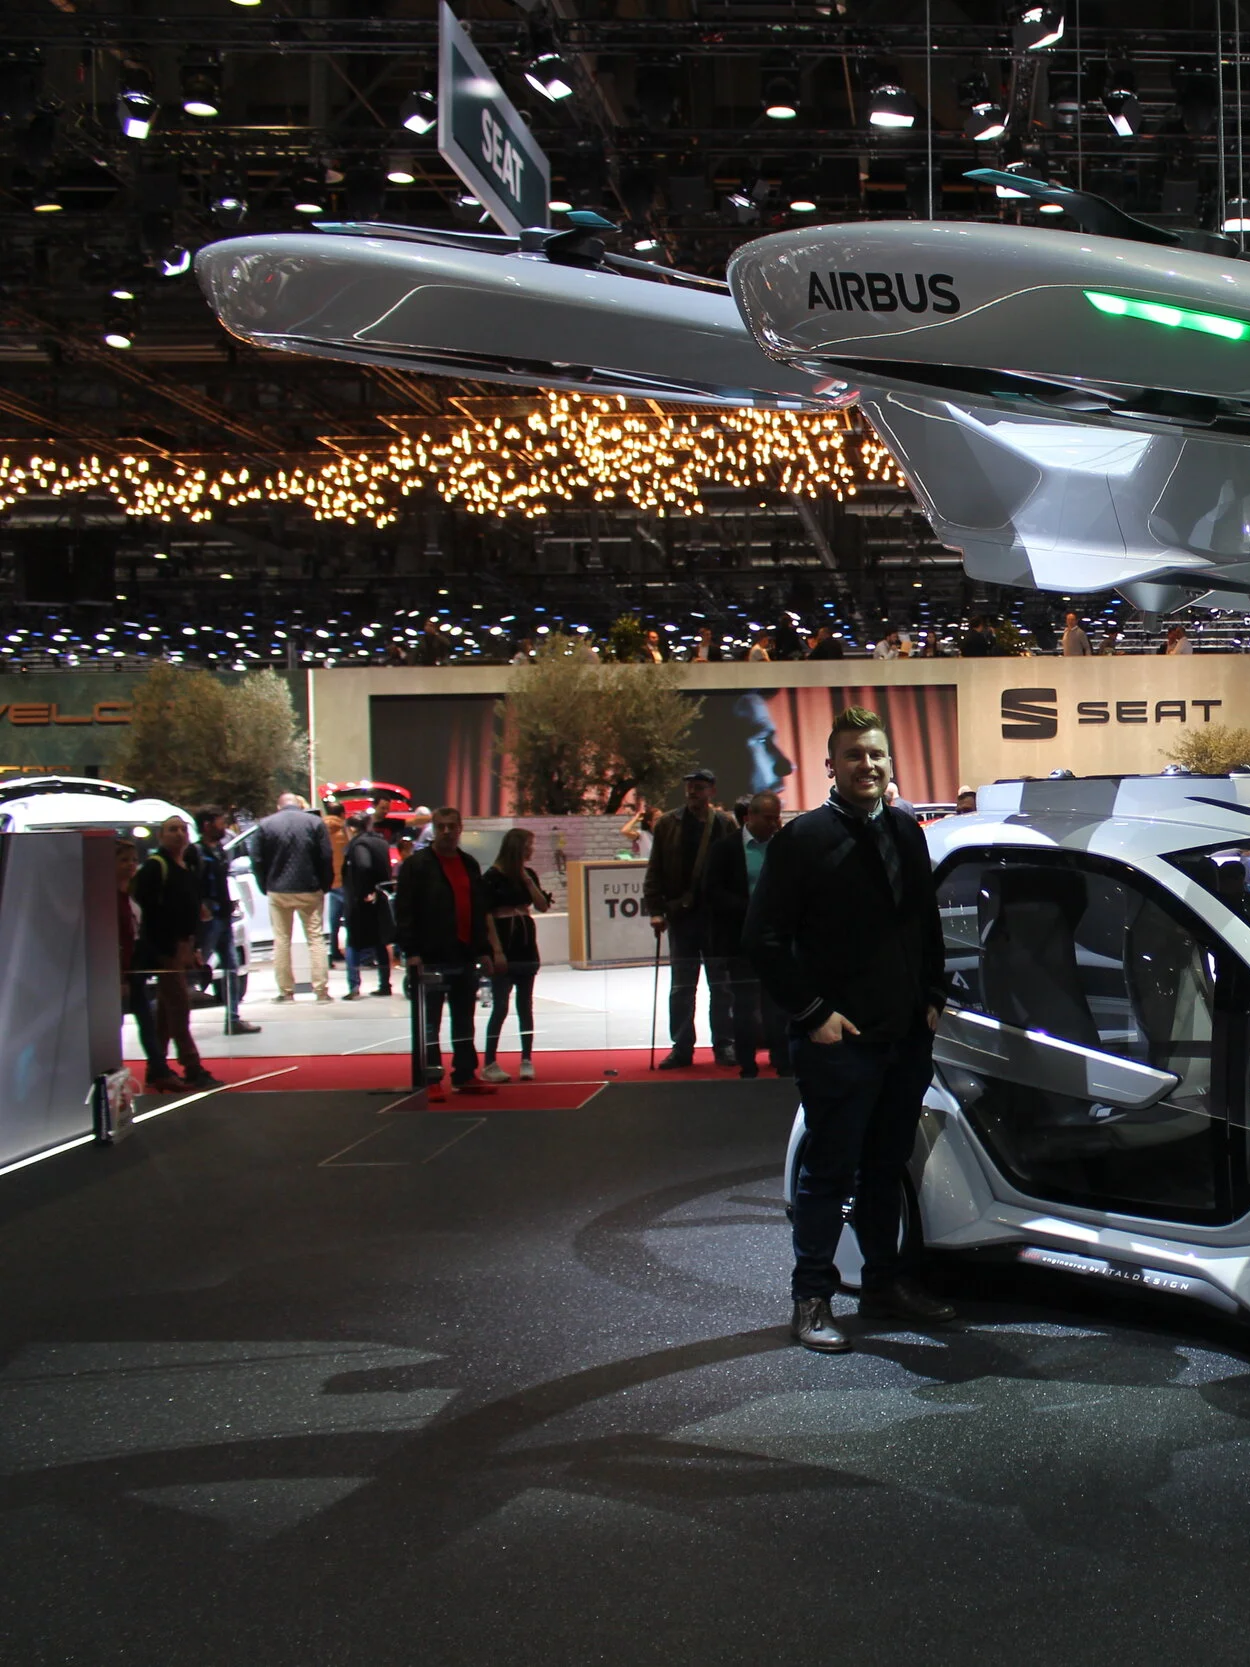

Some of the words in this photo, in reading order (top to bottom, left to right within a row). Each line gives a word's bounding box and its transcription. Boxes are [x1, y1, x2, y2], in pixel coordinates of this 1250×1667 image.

[481, 107, 524, 204] SEAT
[808, 271, 960, 314] AIRBUS
[1077, 700, 1222, 724] SEAT
[603, 883, 645, 894] FUTU
[1042, 1256, 1087, 1271] engineered
[1089, 1265, 1100, 1274] by
[1102, 1267, 1189, 1291] ITALDESIGN
